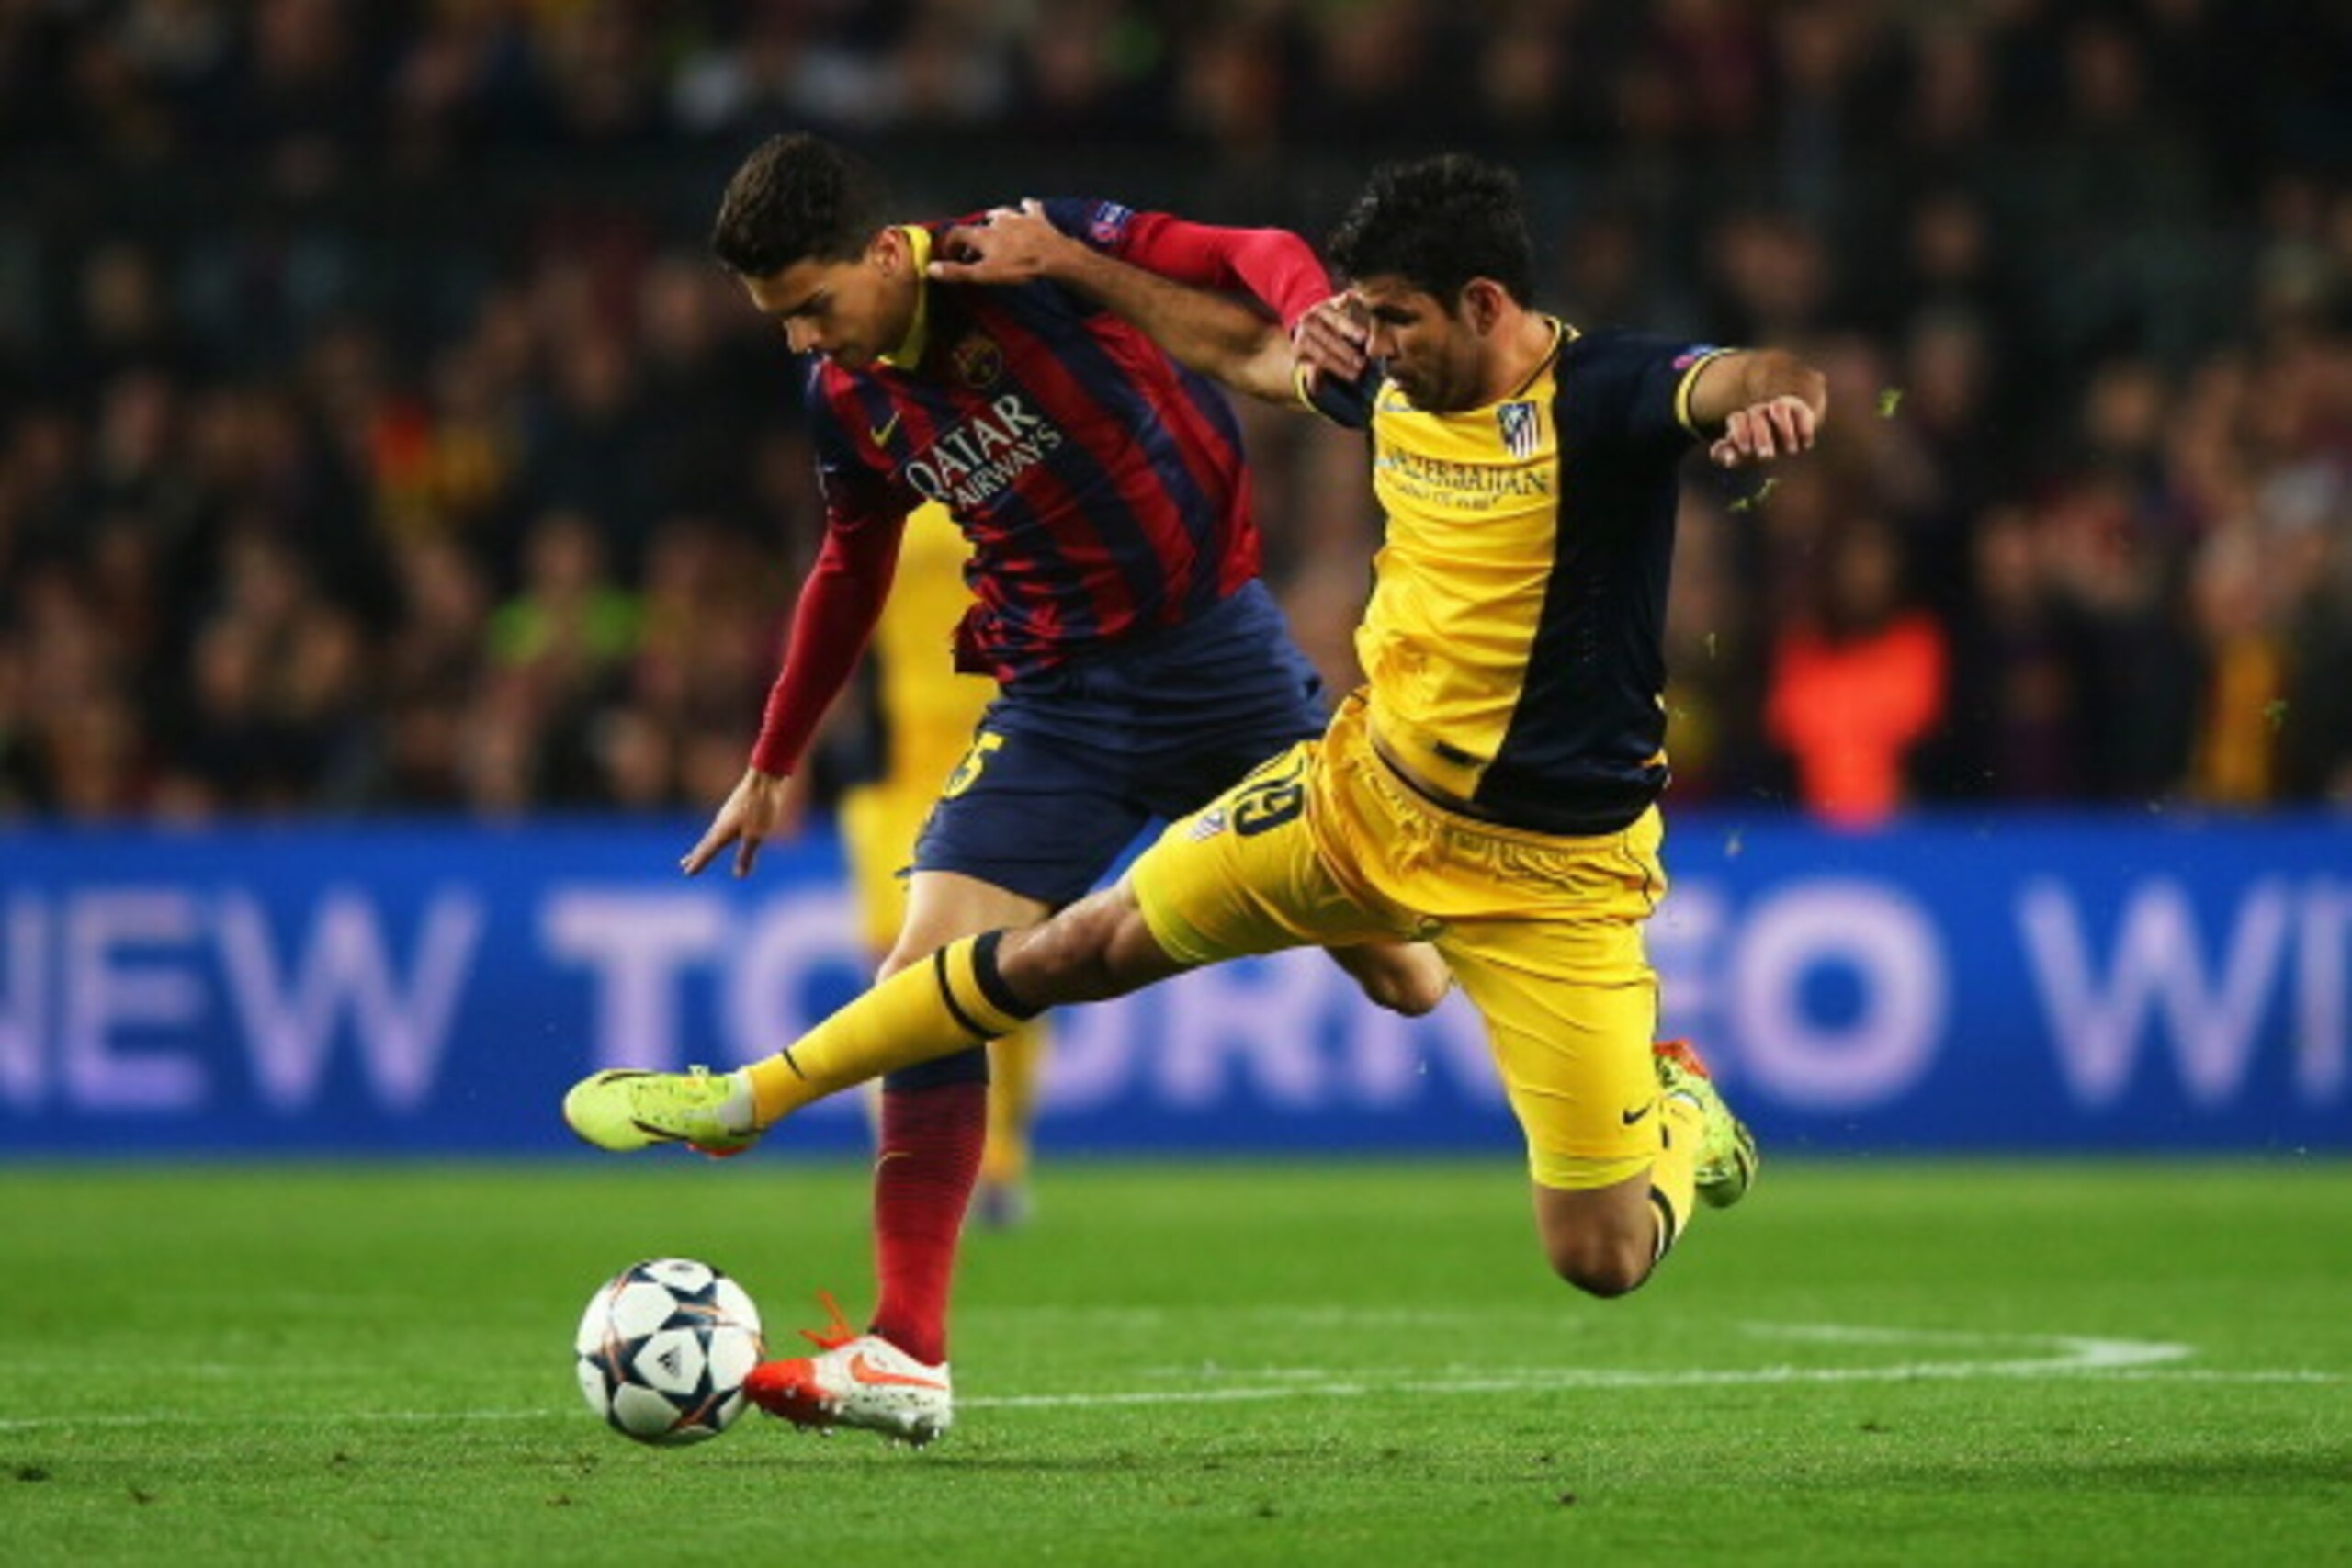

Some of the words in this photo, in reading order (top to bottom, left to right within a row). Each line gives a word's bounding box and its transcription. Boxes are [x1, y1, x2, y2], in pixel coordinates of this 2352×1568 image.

[905, 394, 1039, 501] QATAR
[954, 423, 1061, 511] AIRWAYS
[540, 874, 1950, 1110] TORO
